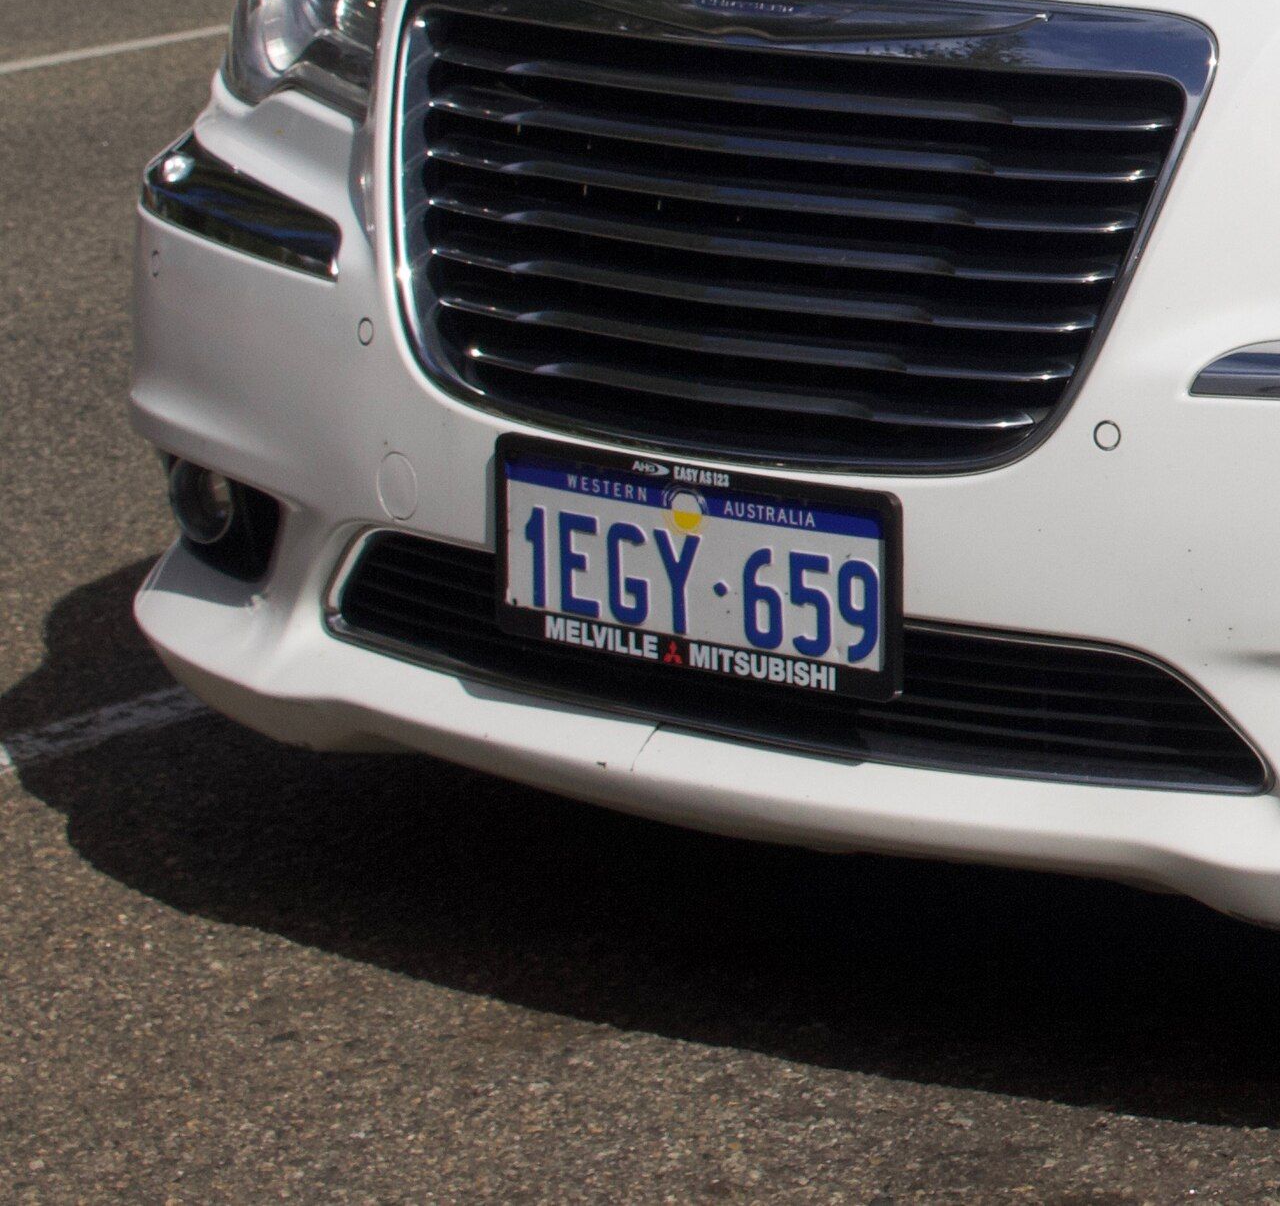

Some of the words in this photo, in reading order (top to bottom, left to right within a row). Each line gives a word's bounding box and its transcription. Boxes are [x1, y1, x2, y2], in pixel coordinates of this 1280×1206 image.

[566, 473, 648, 502] WESTERN
[723, 500, 816, 528] AUSTRALIA
[673, 465, 699, 483] EASY
[699, 470, 712, 485] AS
[713, 472, 730, 487] 123
[545, 615, 659, 660] MELVILLE
[689, 642, 836, 691] MITSUBISHI
